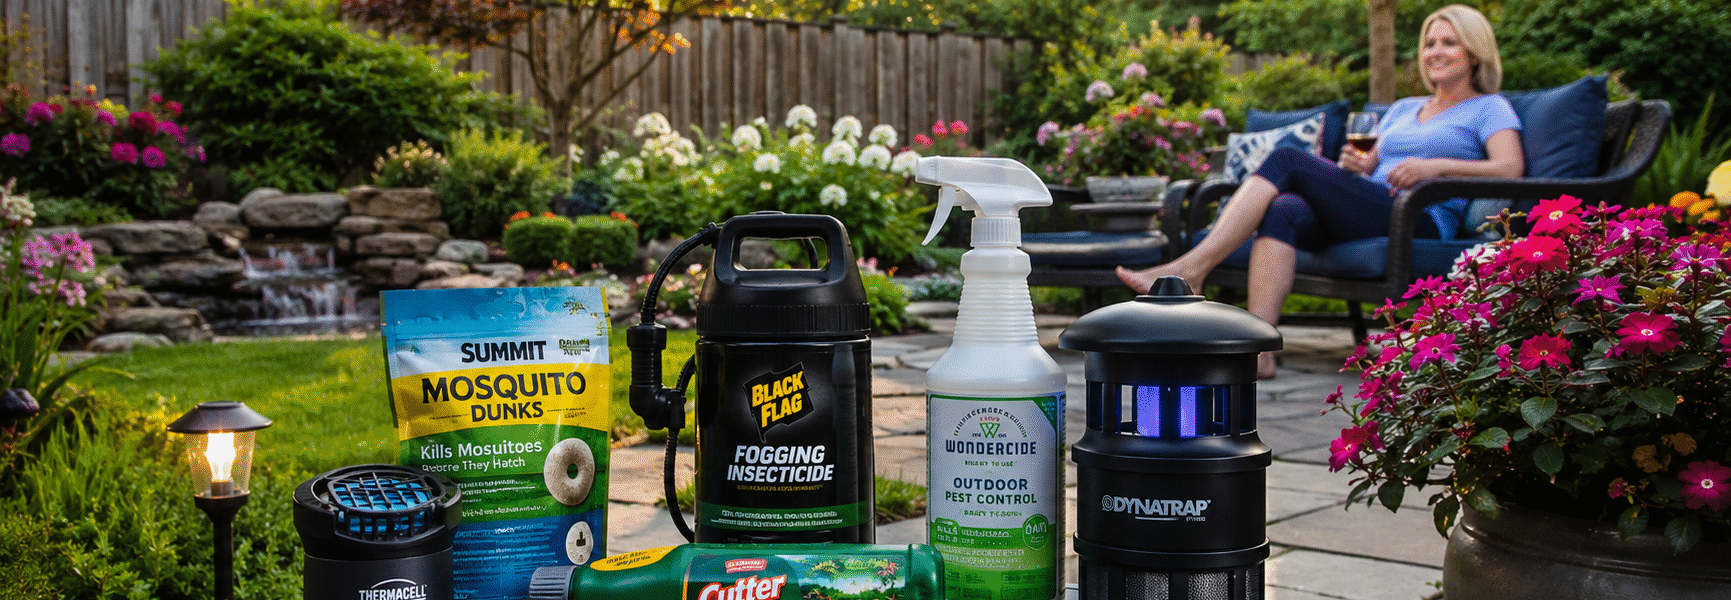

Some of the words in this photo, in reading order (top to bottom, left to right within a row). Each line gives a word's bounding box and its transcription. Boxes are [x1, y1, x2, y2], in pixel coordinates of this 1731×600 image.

[461, 341, 546, 363] SUMMIT
[422, 371, 586, 404] MOSQUITO
[752, 371, 804, 407] BLACK
[471, 402, 544, 422] DUNKS
[761, 393, 802, 427] FLAG
[421, 444, 453, 459] Kills
[735, 445, 825, 464] FOGGING
[945, 440, 1037, 455] WONDERCIDE
[462, 460, 489, 472] They
[493, 456, 525, 469] Hatch
[727, 465, 834, 483] INSECTICIDE
[953, 478, 1028, 490] OUTDOOR
[945, 491, 972, 503] PEST
[977, 494, 1037, 504] CONTROL
[1113, 496, 1208, 516] DYNATRAP
[359, 585, 426, 600] THERMACELL
[698, 574, 787, 600] Cutter
